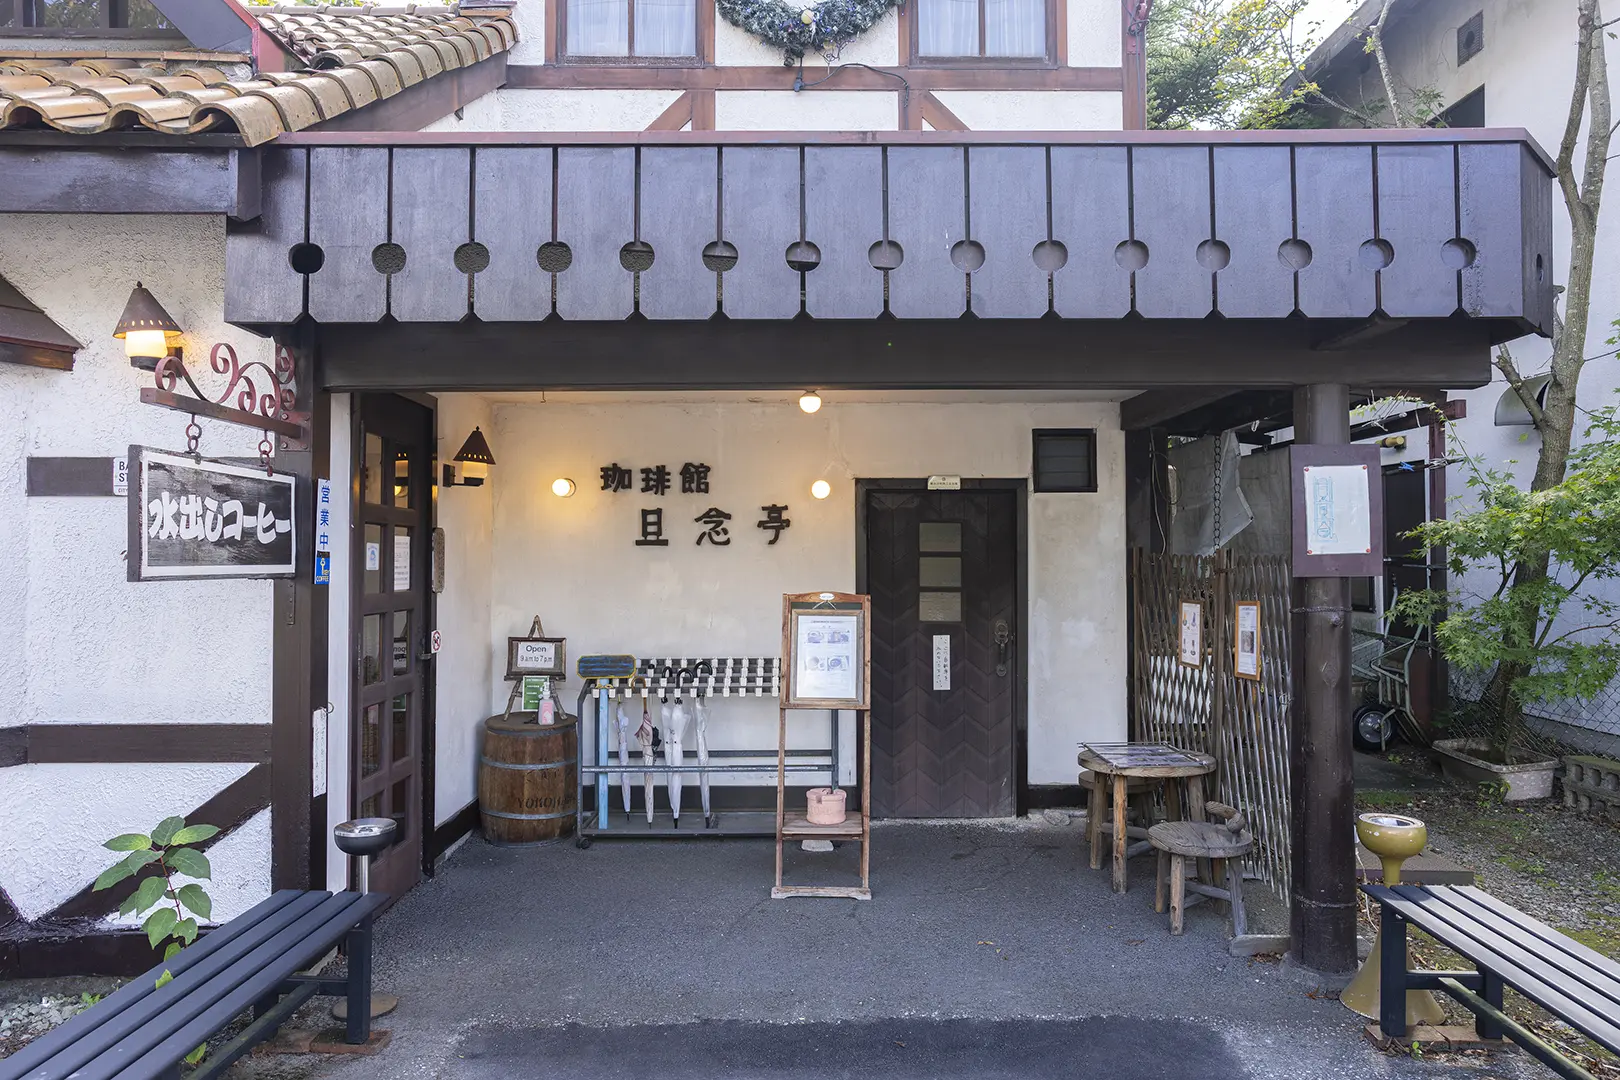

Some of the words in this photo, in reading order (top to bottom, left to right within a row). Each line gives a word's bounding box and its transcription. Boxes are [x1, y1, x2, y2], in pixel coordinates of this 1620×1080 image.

[600, 463, 710, 496] 珈琲館
[148, 492, 291, 544] 水出しコーヒー
[319, 483, 331, 551] 営業中
[526, 645, 546, 653] Open
